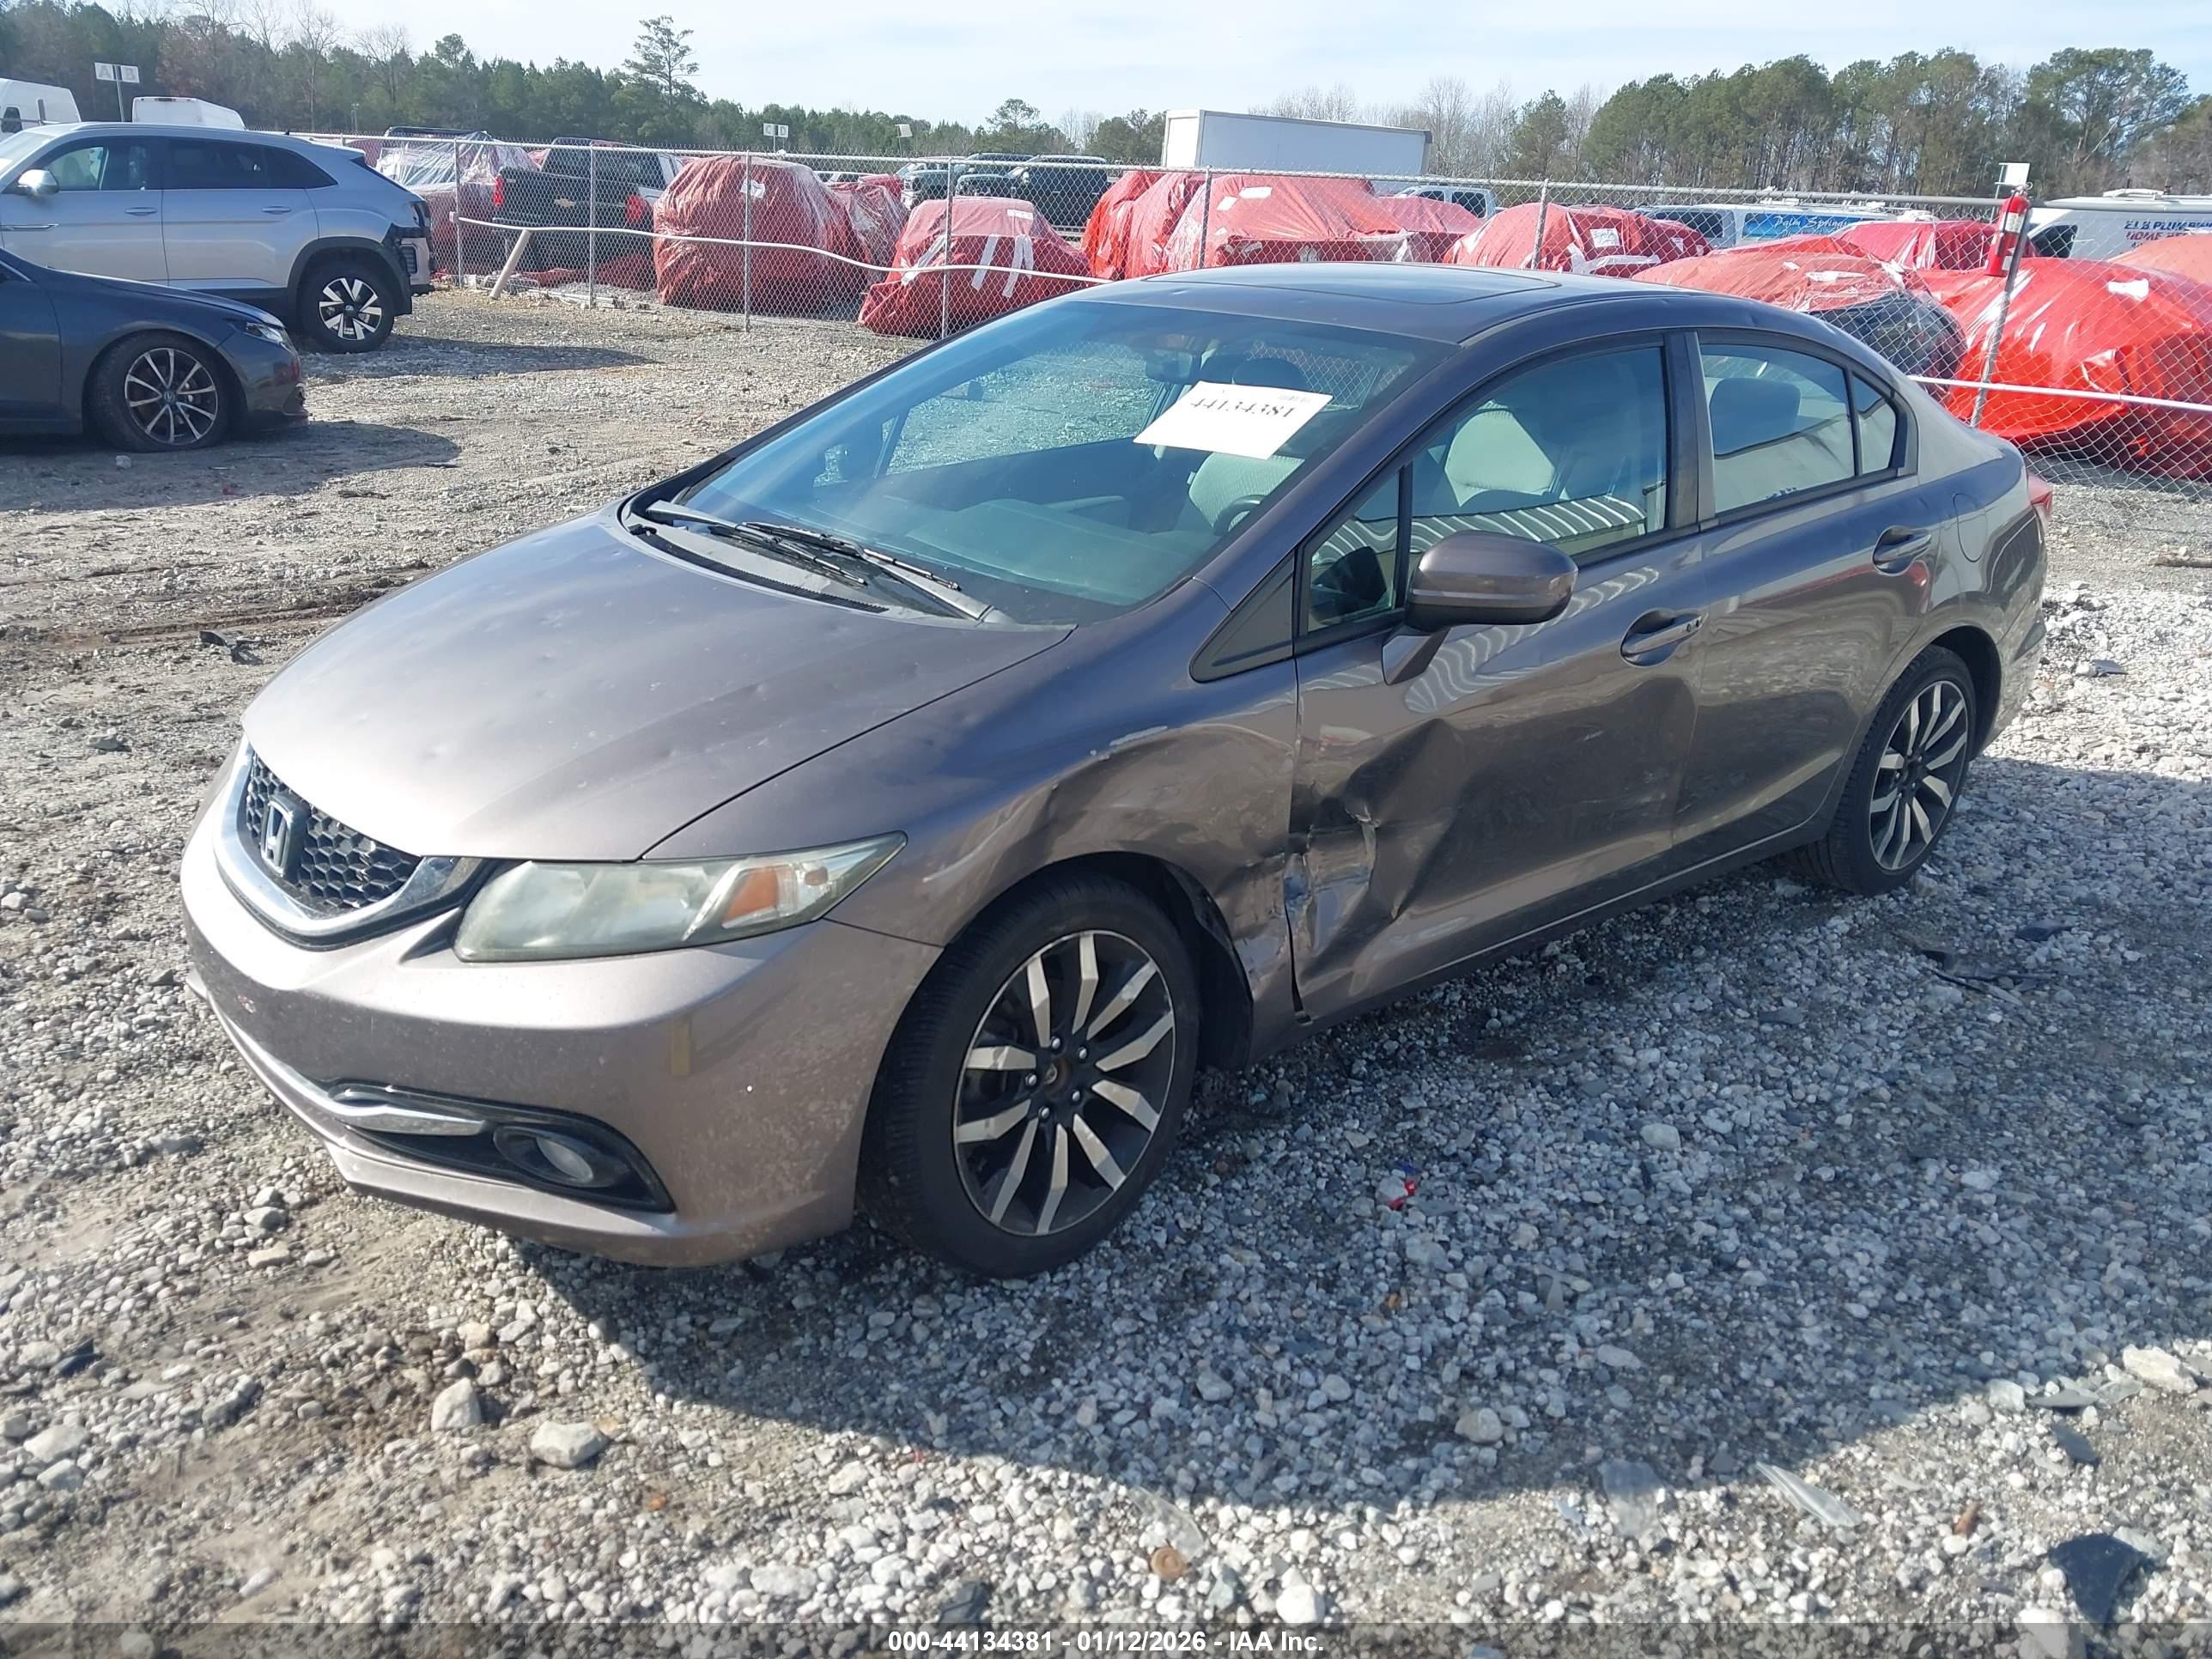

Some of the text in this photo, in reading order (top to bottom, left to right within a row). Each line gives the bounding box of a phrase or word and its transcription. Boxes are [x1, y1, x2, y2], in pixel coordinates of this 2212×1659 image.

[98, 65, 136, 80] A B
[1772, 215, 1801, 228] Palm
[1190, 397, 1298, 419] 44134381
